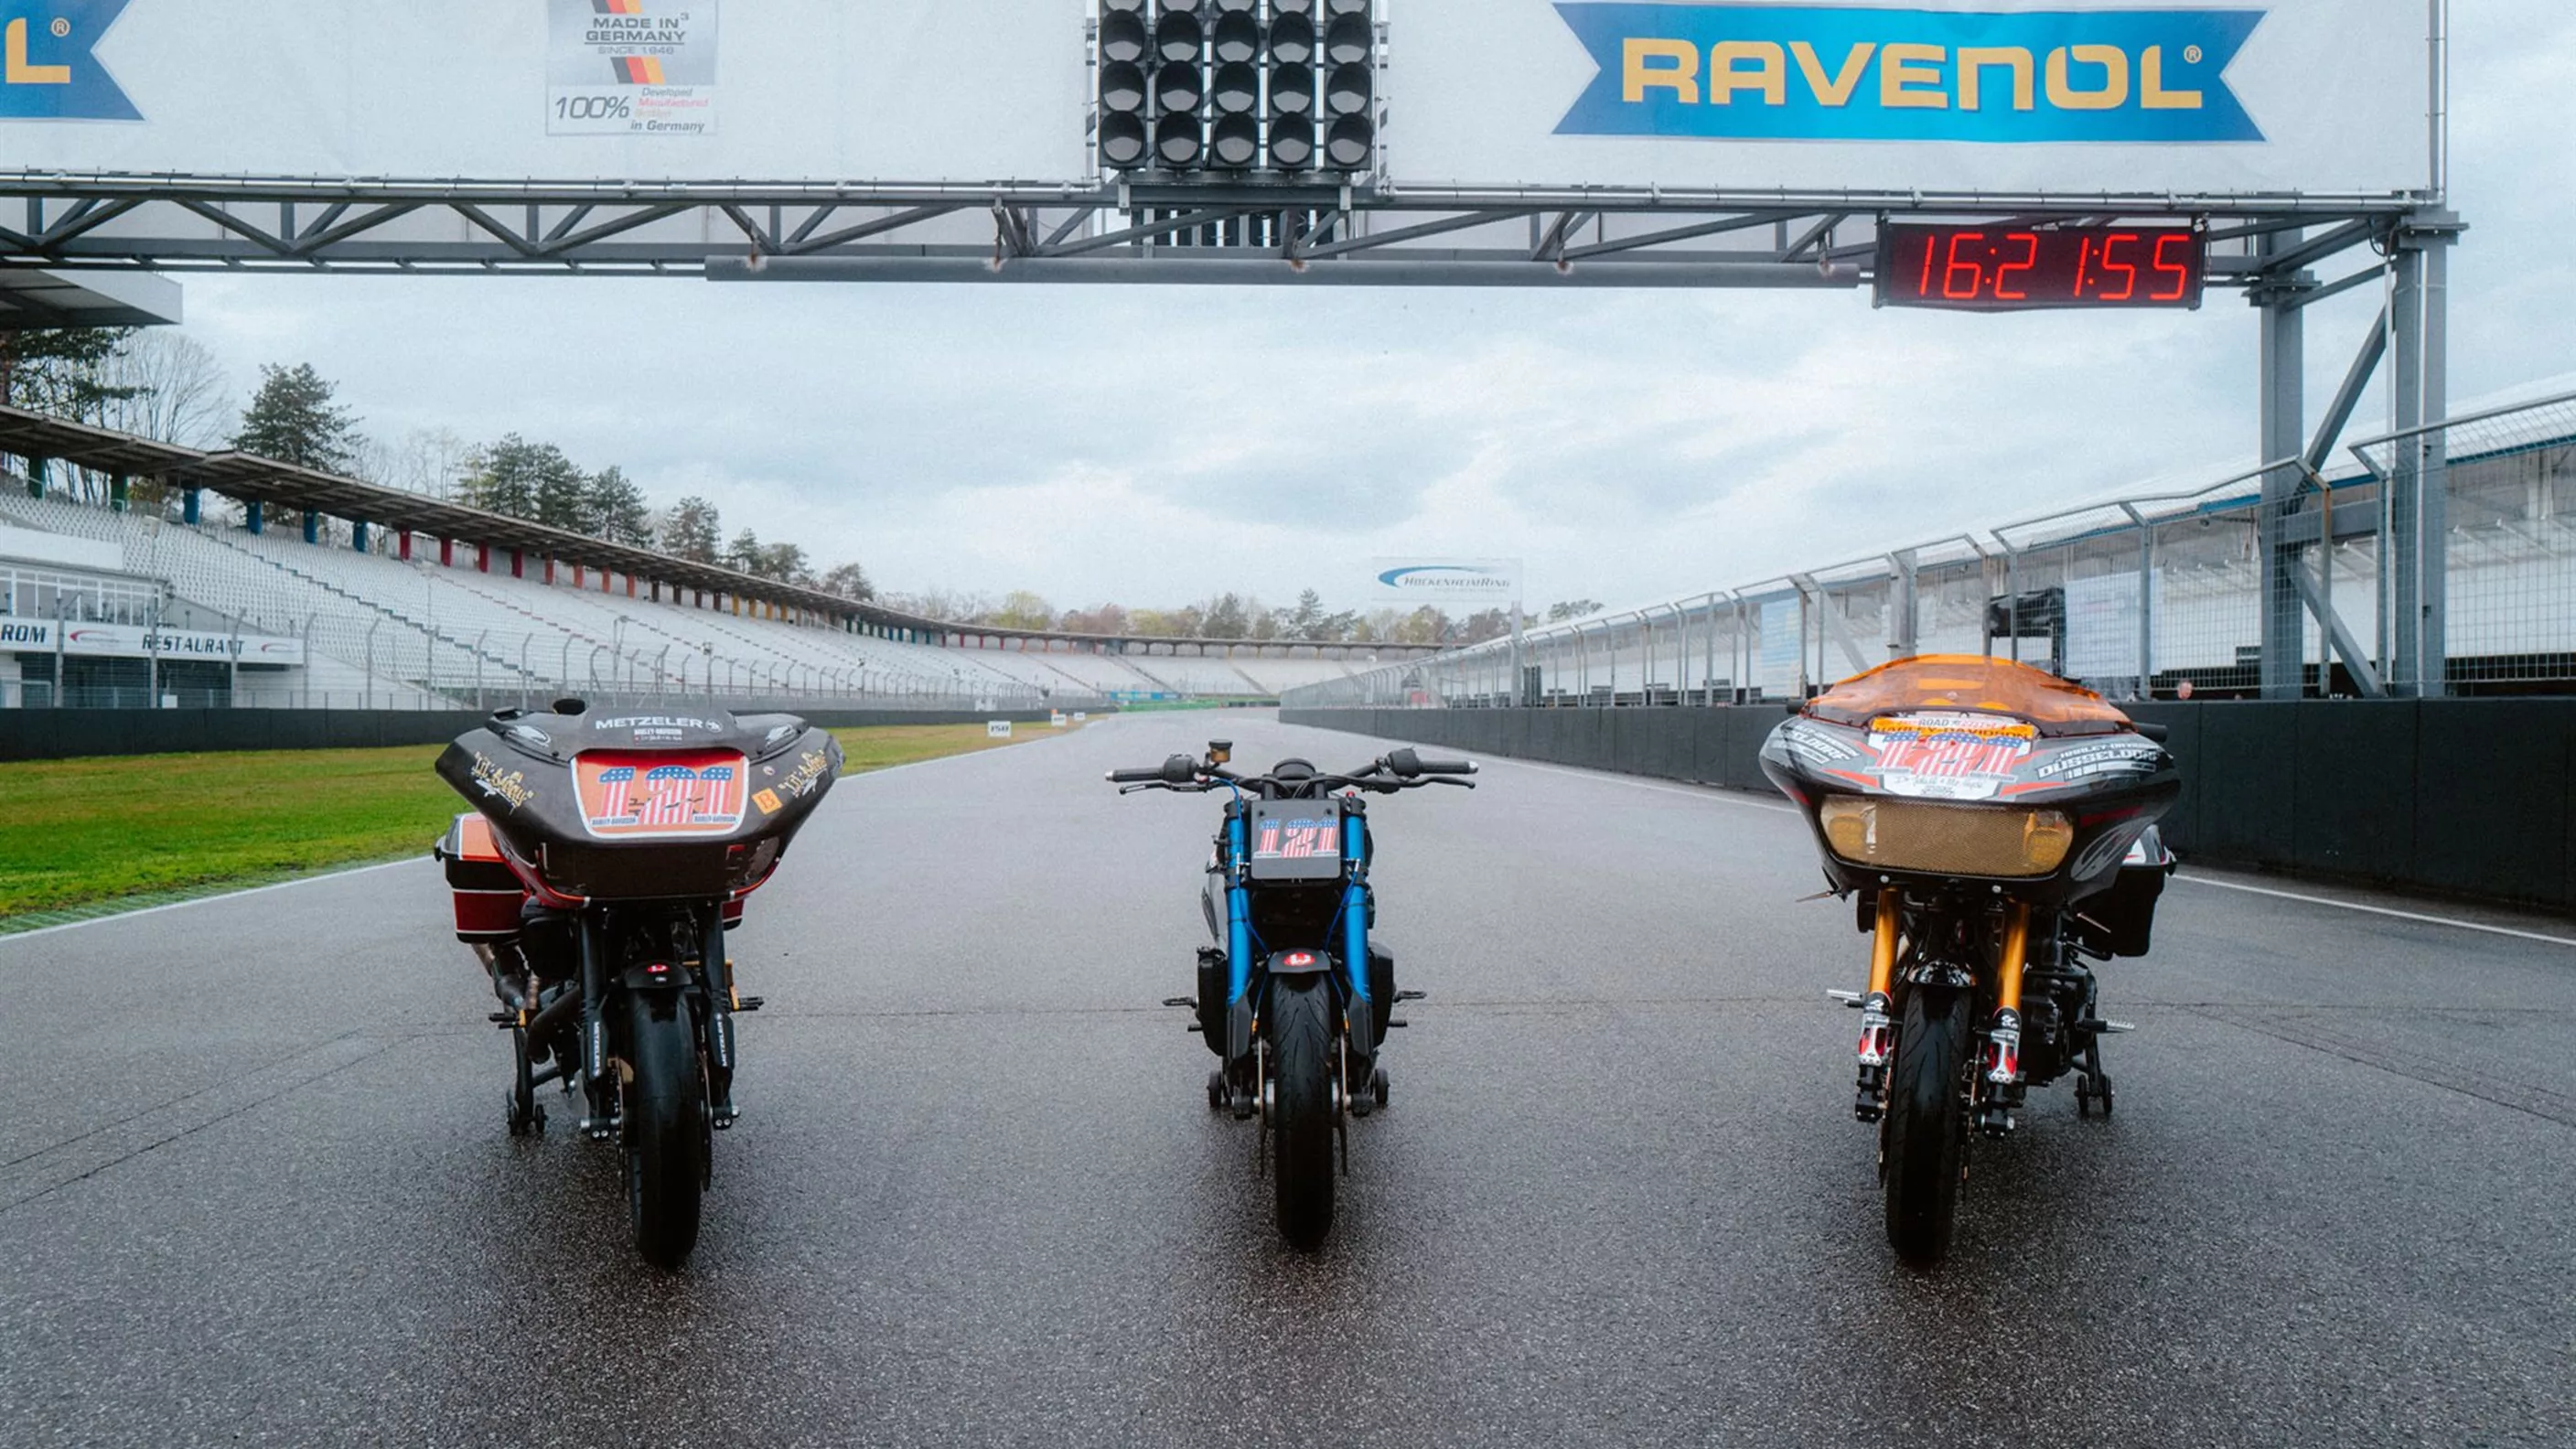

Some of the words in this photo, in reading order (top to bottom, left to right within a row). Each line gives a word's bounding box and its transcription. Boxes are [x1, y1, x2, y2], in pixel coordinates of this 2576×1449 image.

[593, 17, 651, 29] MADE
[585, 30, 686, 42] GERMANY
[597, 46, 636, 55] SINCE
[642, 87, 692, 97] Developed
[555, 96, 630, 120] 100%
[630, 121, 642, 131] in
[646, 121, 705, 134] Germany
[596, 716, 703, 730] METZELER
[1875, 731, 2023, 778] 121
[598, 765, 734, 825] 121
[1259, 817, 1337, 858] 121
